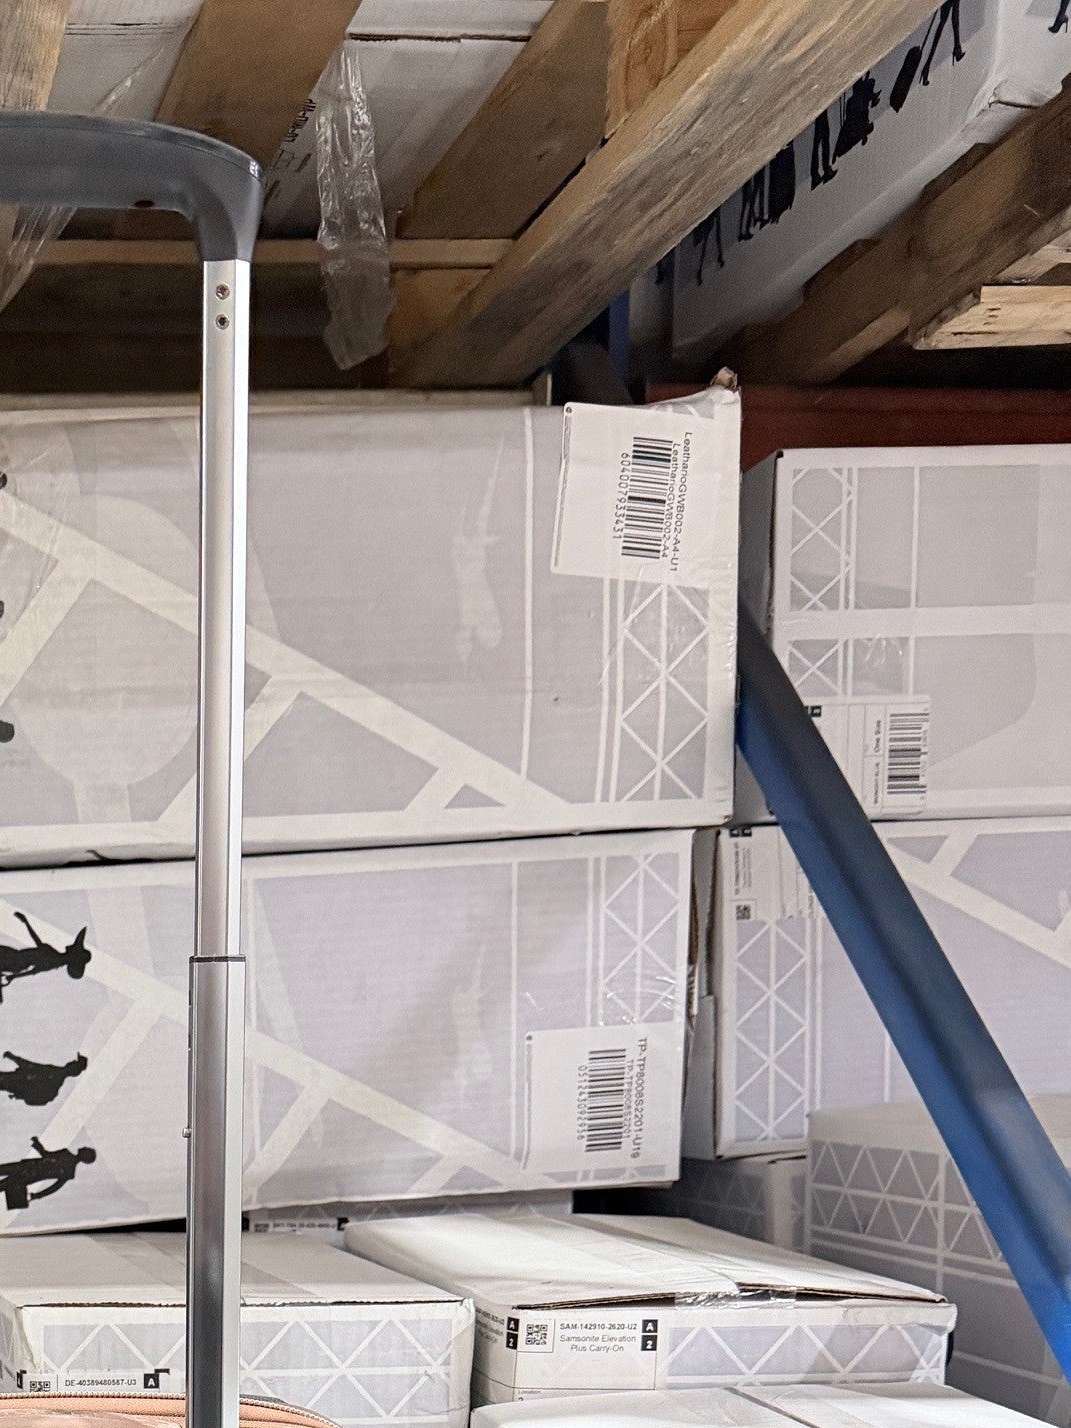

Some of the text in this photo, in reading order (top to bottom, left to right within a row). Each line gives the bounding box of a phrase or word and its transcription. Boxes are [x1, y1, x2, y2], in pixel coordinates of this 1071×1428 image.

[612, 452, 630, 540] 604007933431
[630, 1037, 647, 1159] TP-TP8008S2201-U19
[559, 1334, 637, 1343] Samsonite Elevation
[570, 1344, 587, 1352] Plus
